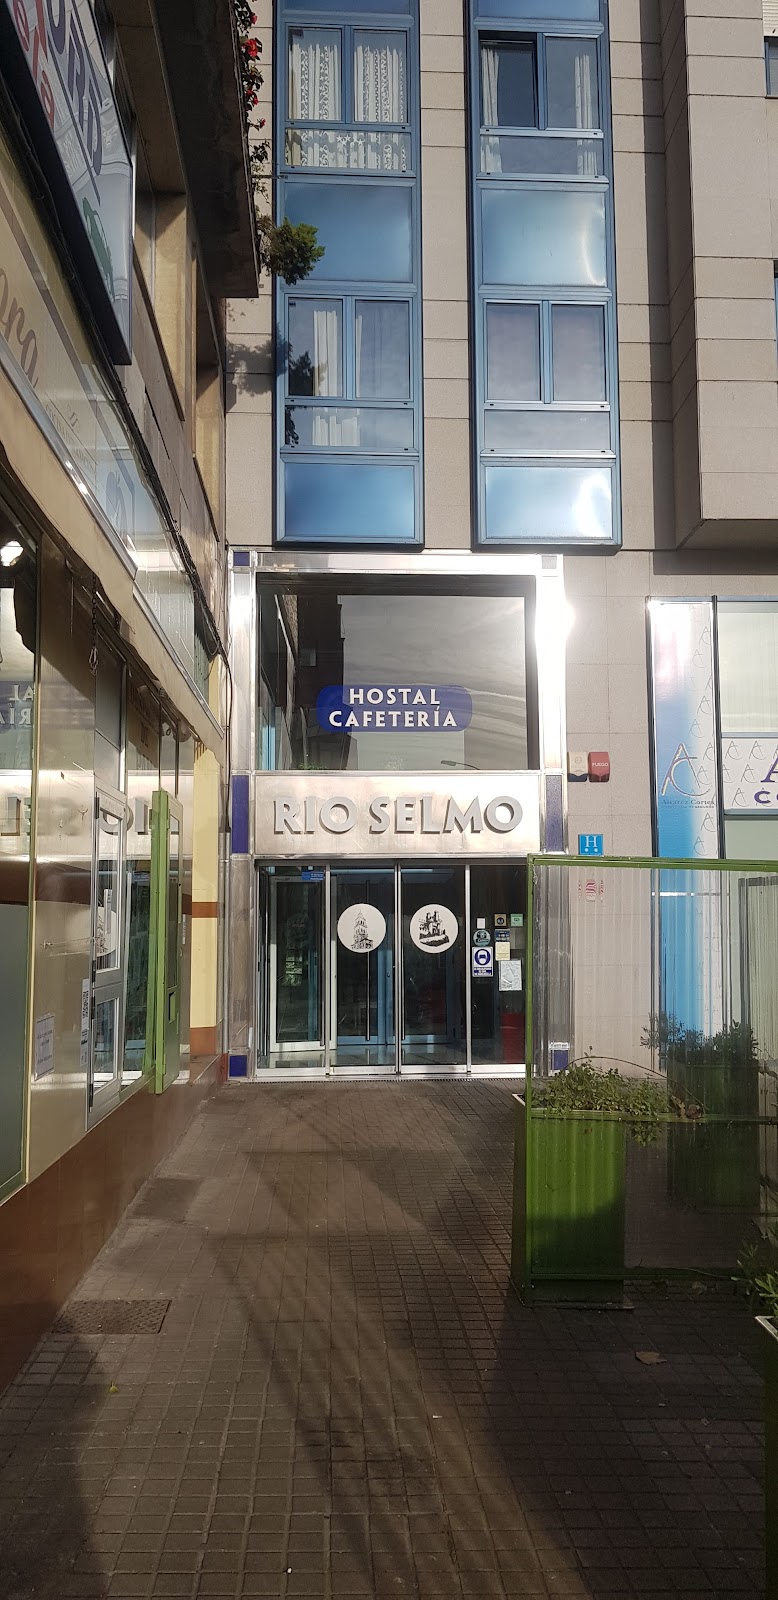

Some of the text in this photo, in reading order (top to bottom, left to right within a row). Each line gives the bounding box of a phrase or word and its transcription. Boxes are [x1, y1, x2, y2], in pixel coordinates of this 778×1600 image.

[349, 688, 441, 705] HOSTAL
[328, 706, 458, 727] CAFETERÍA
[273, 795, 523, 835] RIO SELMO
[585, 836, 598, 848] H
